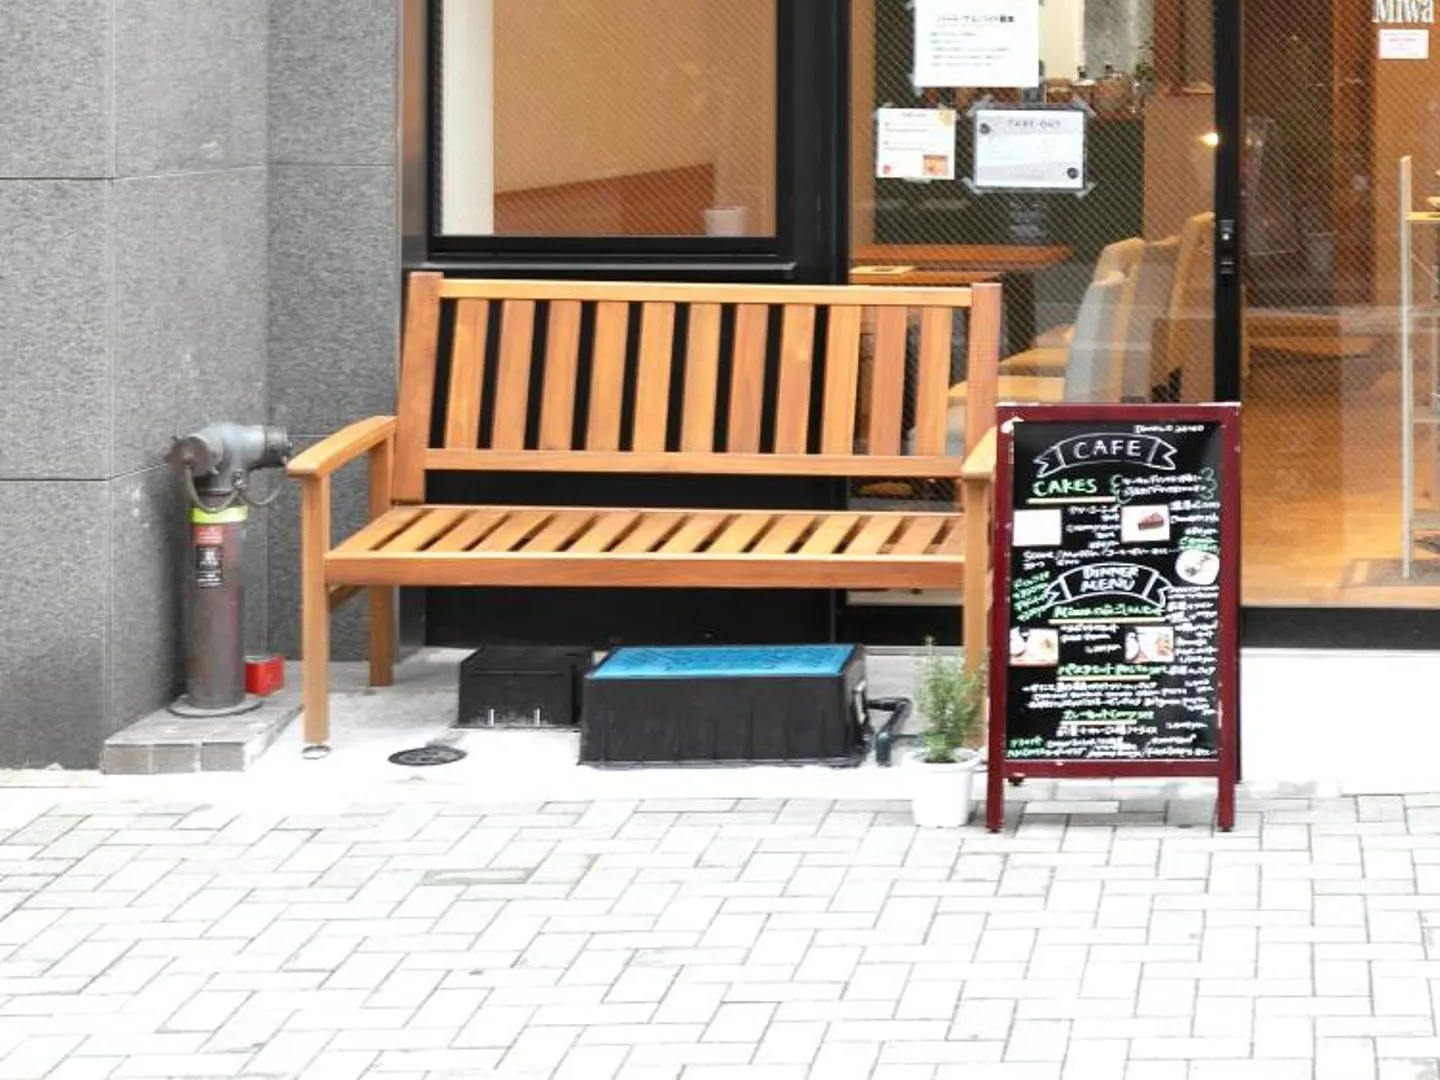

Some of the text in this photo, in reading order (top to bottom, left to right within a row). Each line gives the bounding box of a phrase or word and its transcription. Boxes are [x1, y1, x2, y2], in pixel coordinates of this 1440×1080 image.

[1072, 439, 1142, 460] CAFE
[1032, 477, 1098, 496] CAKES
[1082, 566, 1140, 580] DINNER
[1079, 579, 1136, 592] MENU
